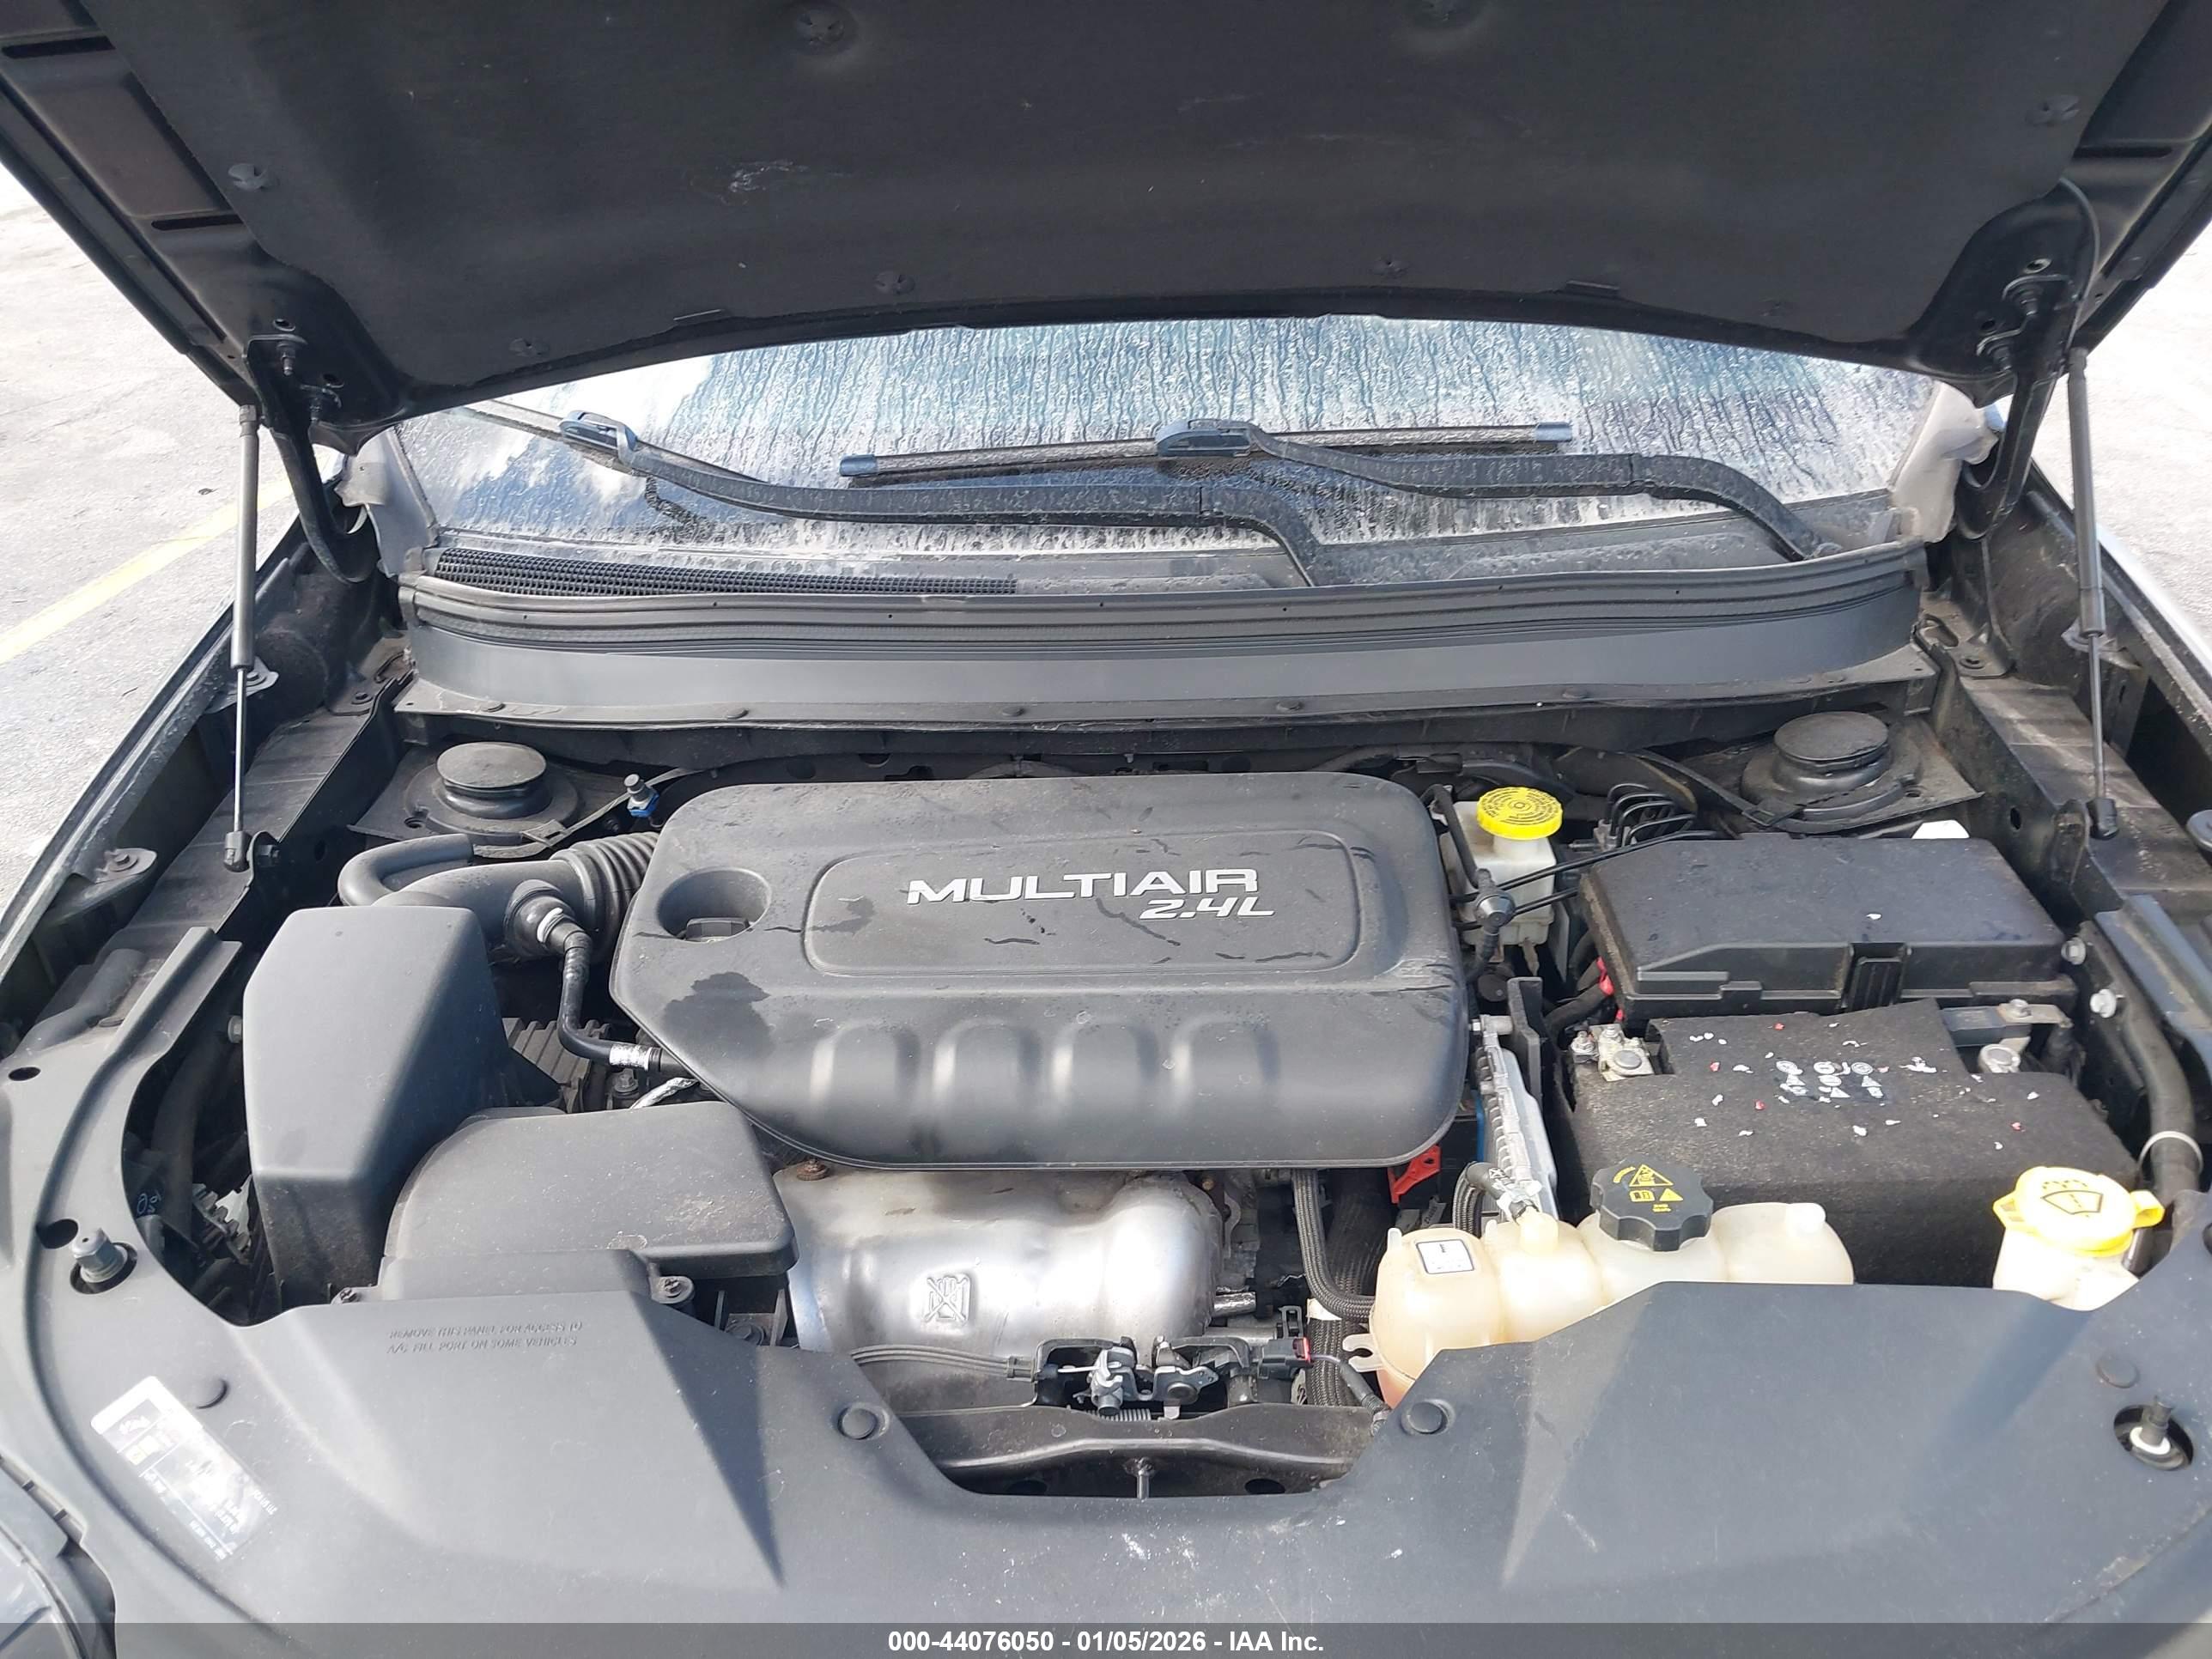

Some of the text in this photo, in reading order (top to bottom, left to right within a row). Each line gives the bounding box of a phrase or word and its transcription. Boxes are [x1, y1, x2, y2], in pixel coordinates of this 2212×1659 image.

[906, 867, 1259, 905] MULTIAIR
[1139, 896, 1275, 921] 2.4L
[524, 1322, 566, 1334] ACCESS
[438, 1340, 468, 1352] PORT
[471, 1339, 488, 1350] ON
[491, 1338, 522, 1349] SOME
[526, 1336, 577, 1347] VEHICLES
